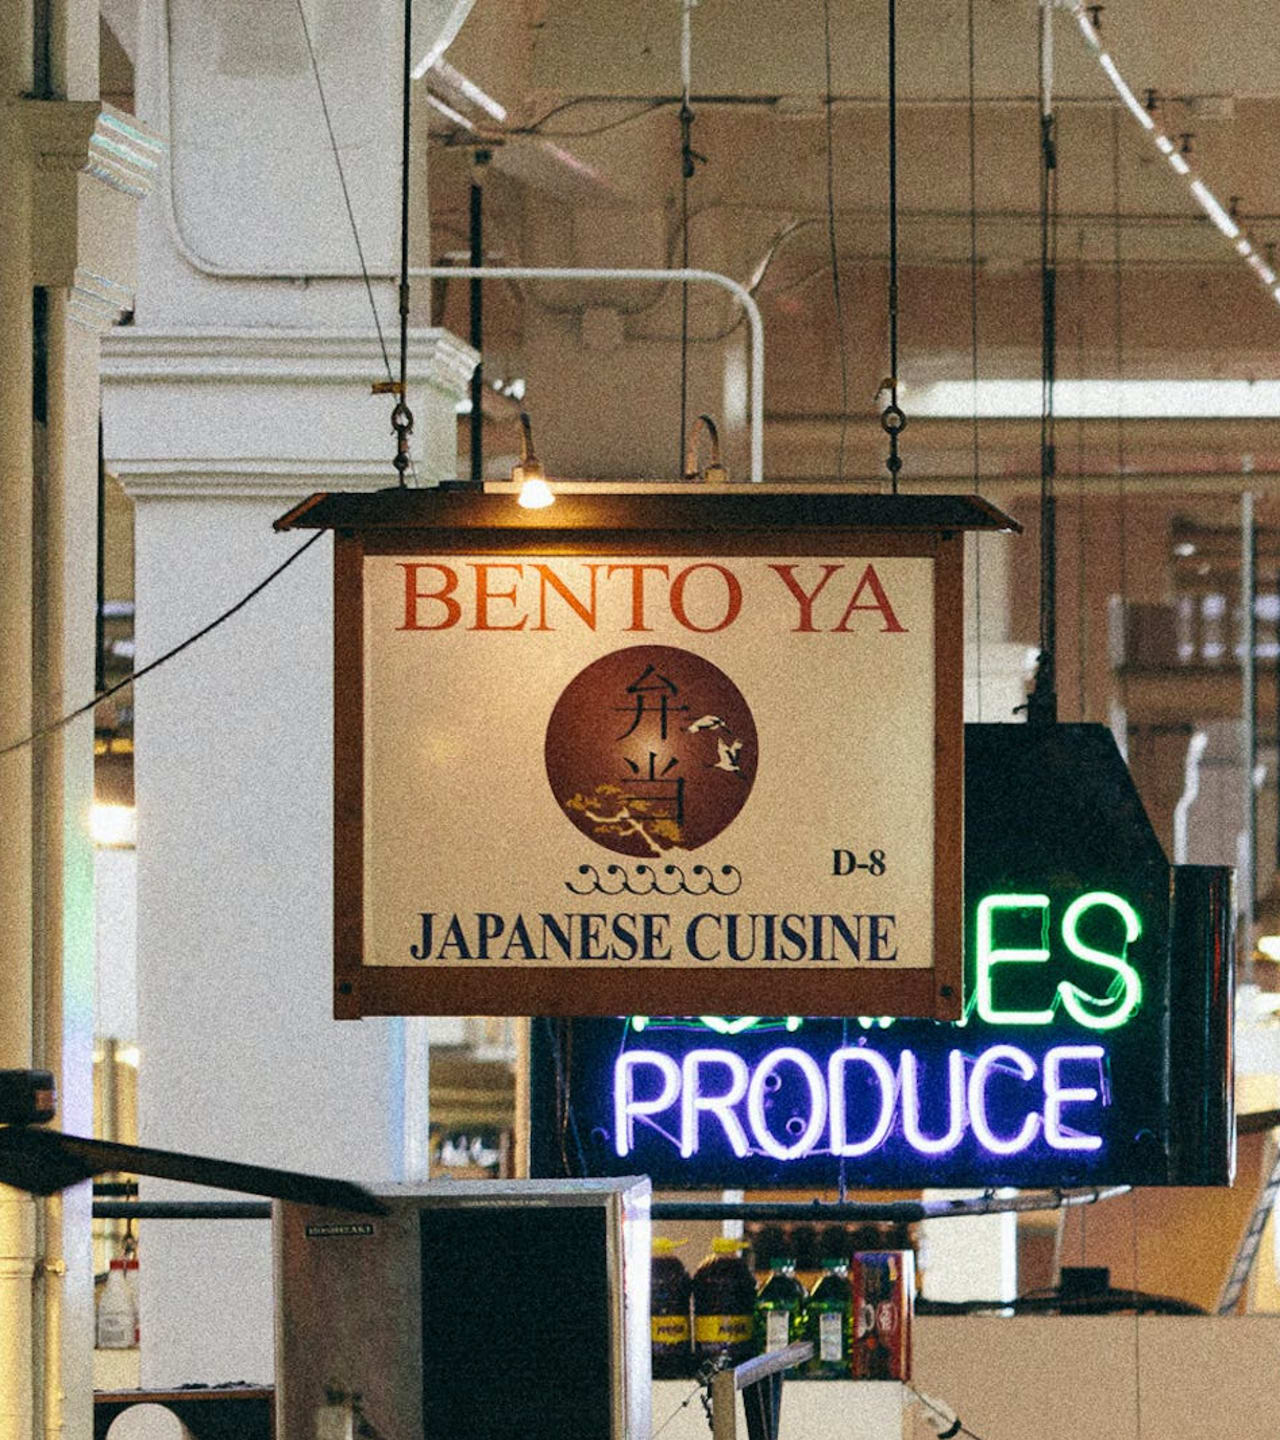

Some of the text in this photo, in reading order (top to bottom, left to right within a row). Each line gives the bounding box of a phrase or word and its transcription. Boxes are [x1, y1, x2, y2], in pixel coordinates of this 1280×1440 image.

[395, 562, 909, 633] BENTO YA
[611, 664, 690, 827] 弁当
[831, 848, 887, 877] D-8
[410, 911, 897, 963] JAPANESE CUISINE
[615, 1044, 1106, 1160] PRODUCE
